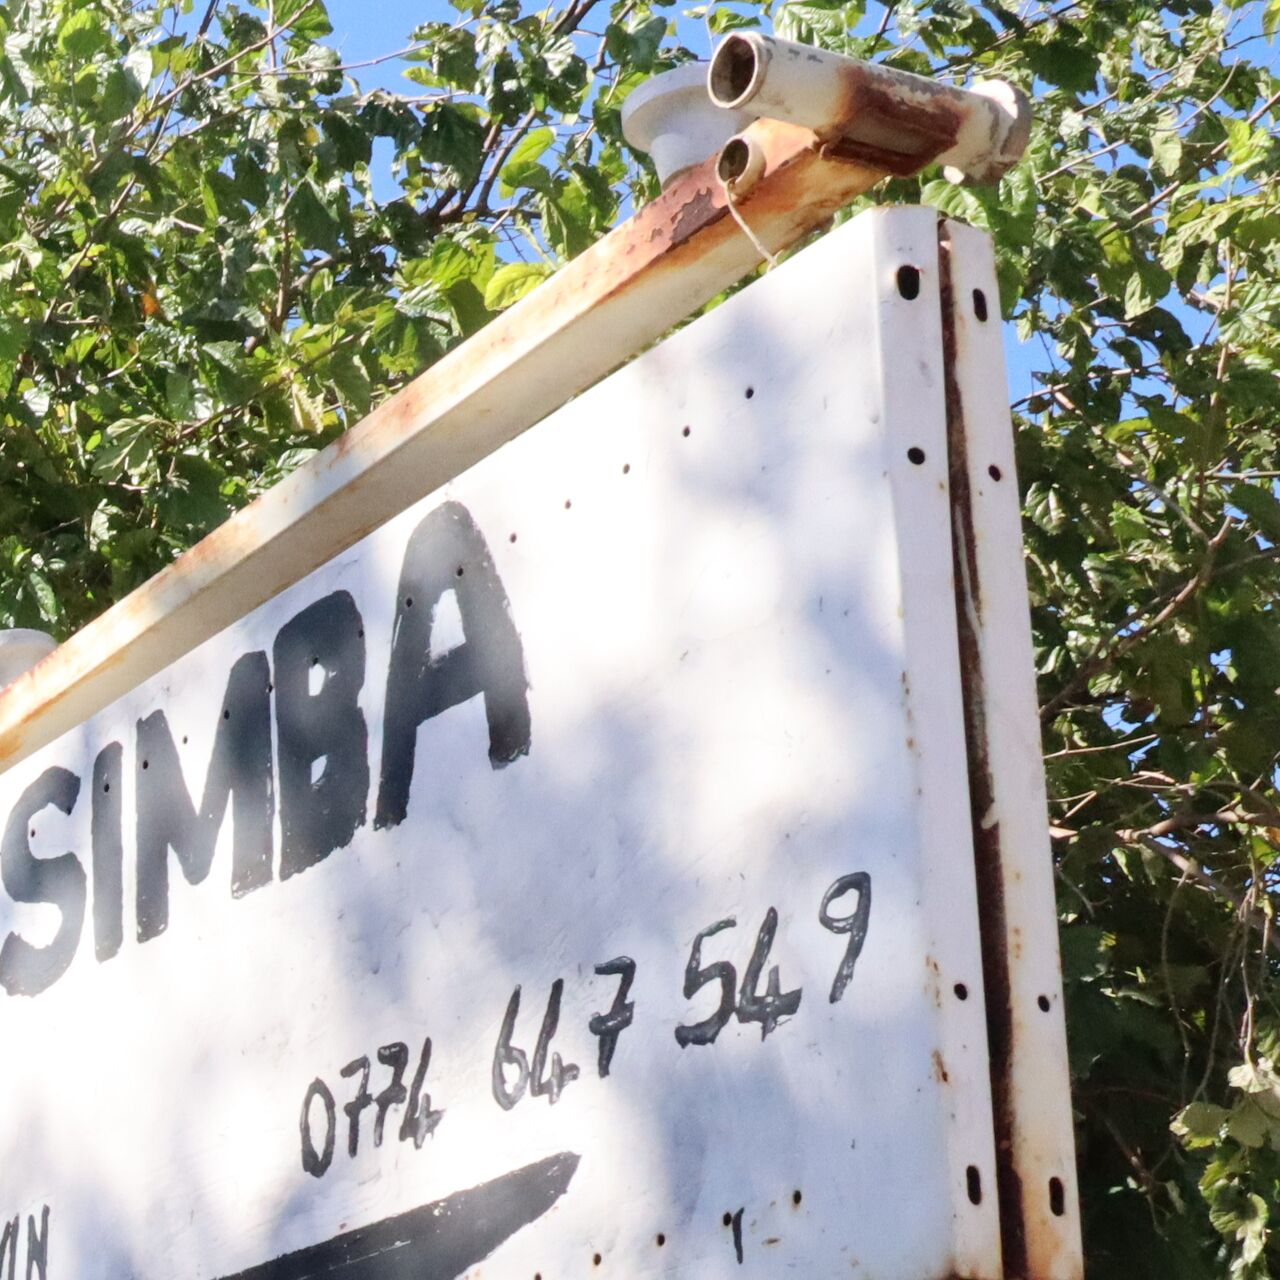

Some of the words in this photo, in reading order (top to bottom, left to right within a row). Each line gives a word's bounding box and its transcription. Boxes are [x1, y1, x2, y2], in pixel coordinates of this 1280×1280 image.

[301, 1037, 444, 1178] 0774
[492, 956, 636, 1110] 647
[675, 872, 871, 1049] 549
